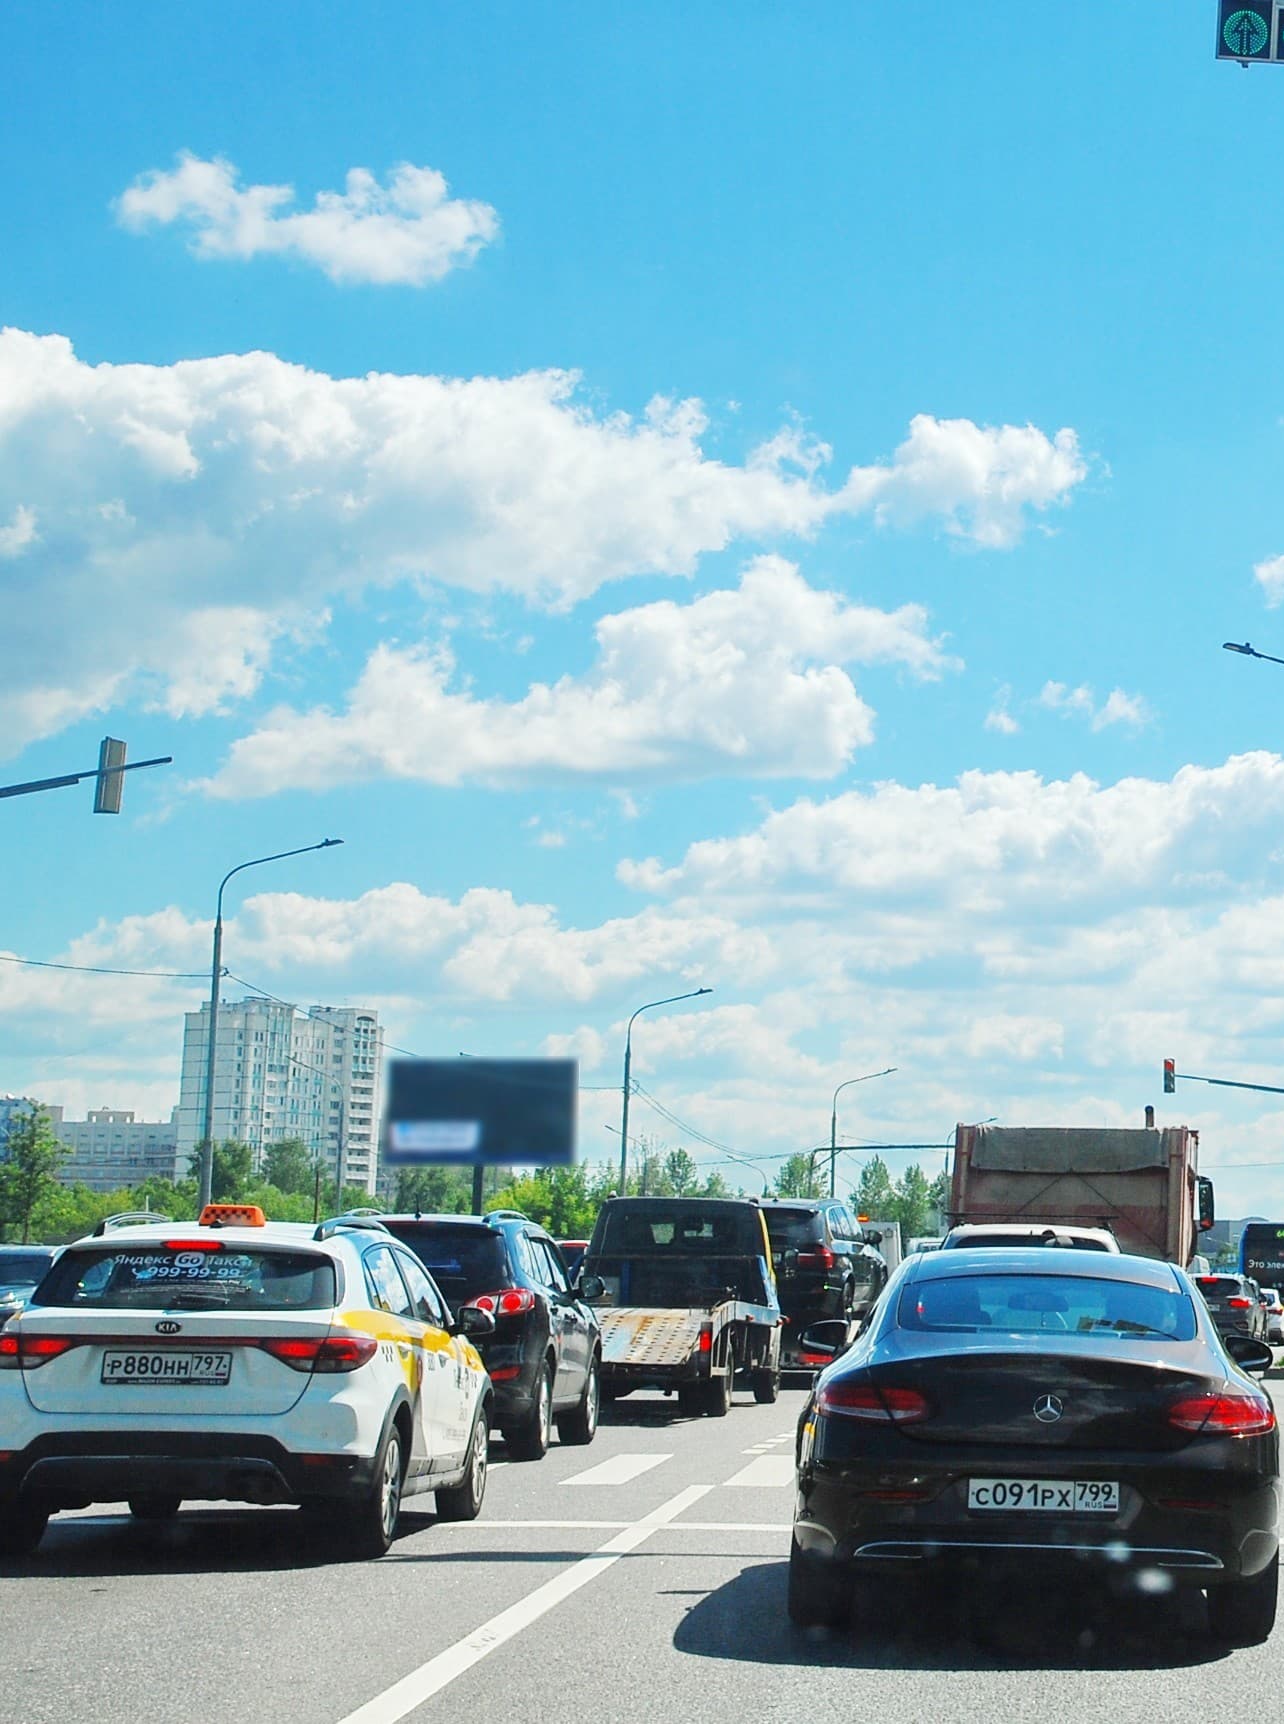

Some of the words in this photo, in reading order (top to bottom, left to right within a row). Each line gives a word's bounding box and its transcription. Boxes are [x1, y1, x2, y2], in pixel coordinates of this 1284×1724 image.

[114, 1254, 171, 1266] Яндекс
[180, 1254, 200, 1265] Go
[1248, 1259, 1264, 1269] Это
[149, 1266, 242, 1278] 999-99-99
[157, 1322, 178, 1332] KIA
[110, 1356, 189, 1375] Р880НН
[194, 1356, 224, 1370] 797
[975, 1482, 1071, 1507] С091РХ
[1077, 1483, 1113, 1501] 799
[1085, 1501, 1103, 1509] RUS
